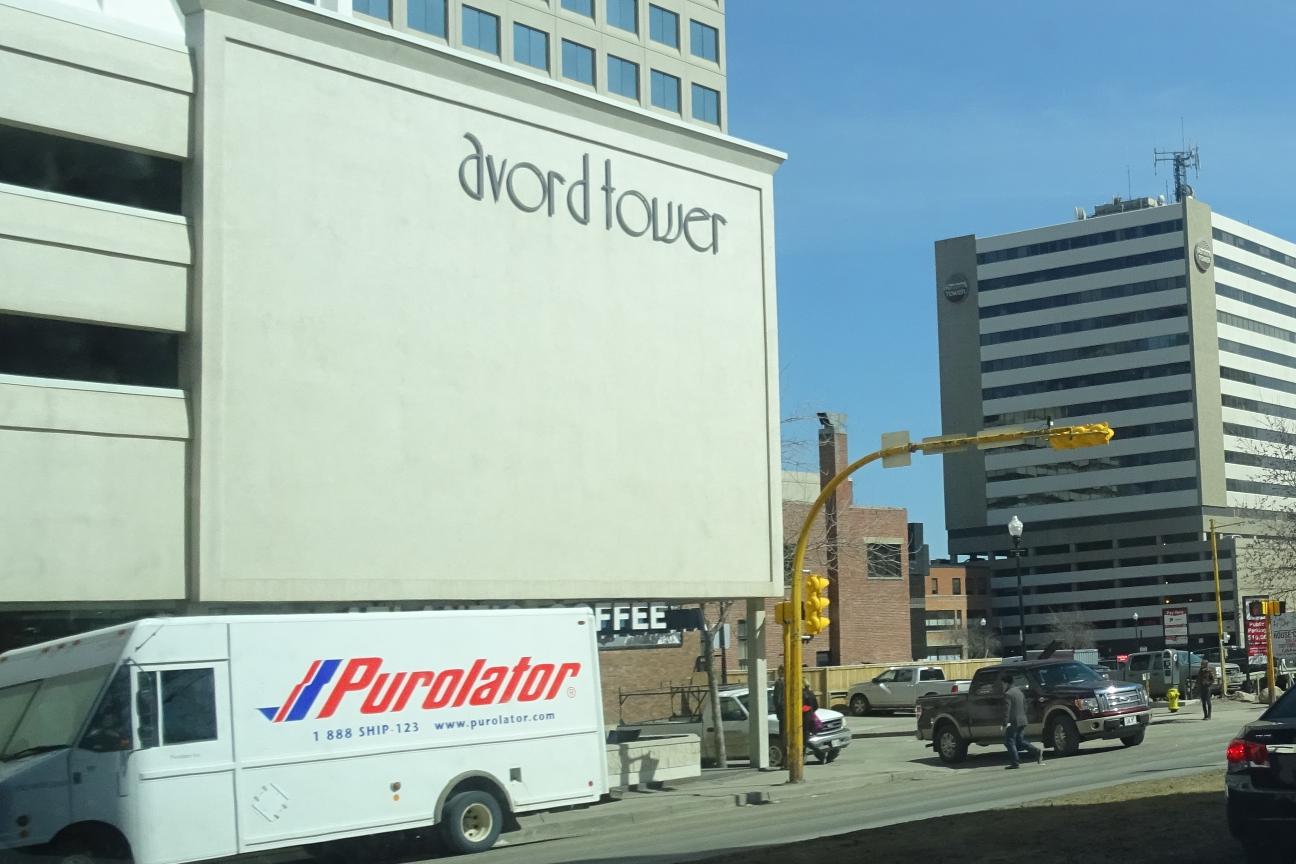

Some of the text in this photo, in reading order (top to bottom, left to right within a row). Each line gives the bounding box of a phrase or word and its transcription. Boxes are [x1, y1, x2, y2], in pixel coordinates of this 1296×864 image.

[458, 131, 728, 255] avord tower
[594, 604, 669, 631] FFEE
[315, 656, 582, 719] Purolator
[313, 731, 319, 742] 1
[326, 728, 353, 740] 888
[434, 711, 556, 730] www.purolator.com
